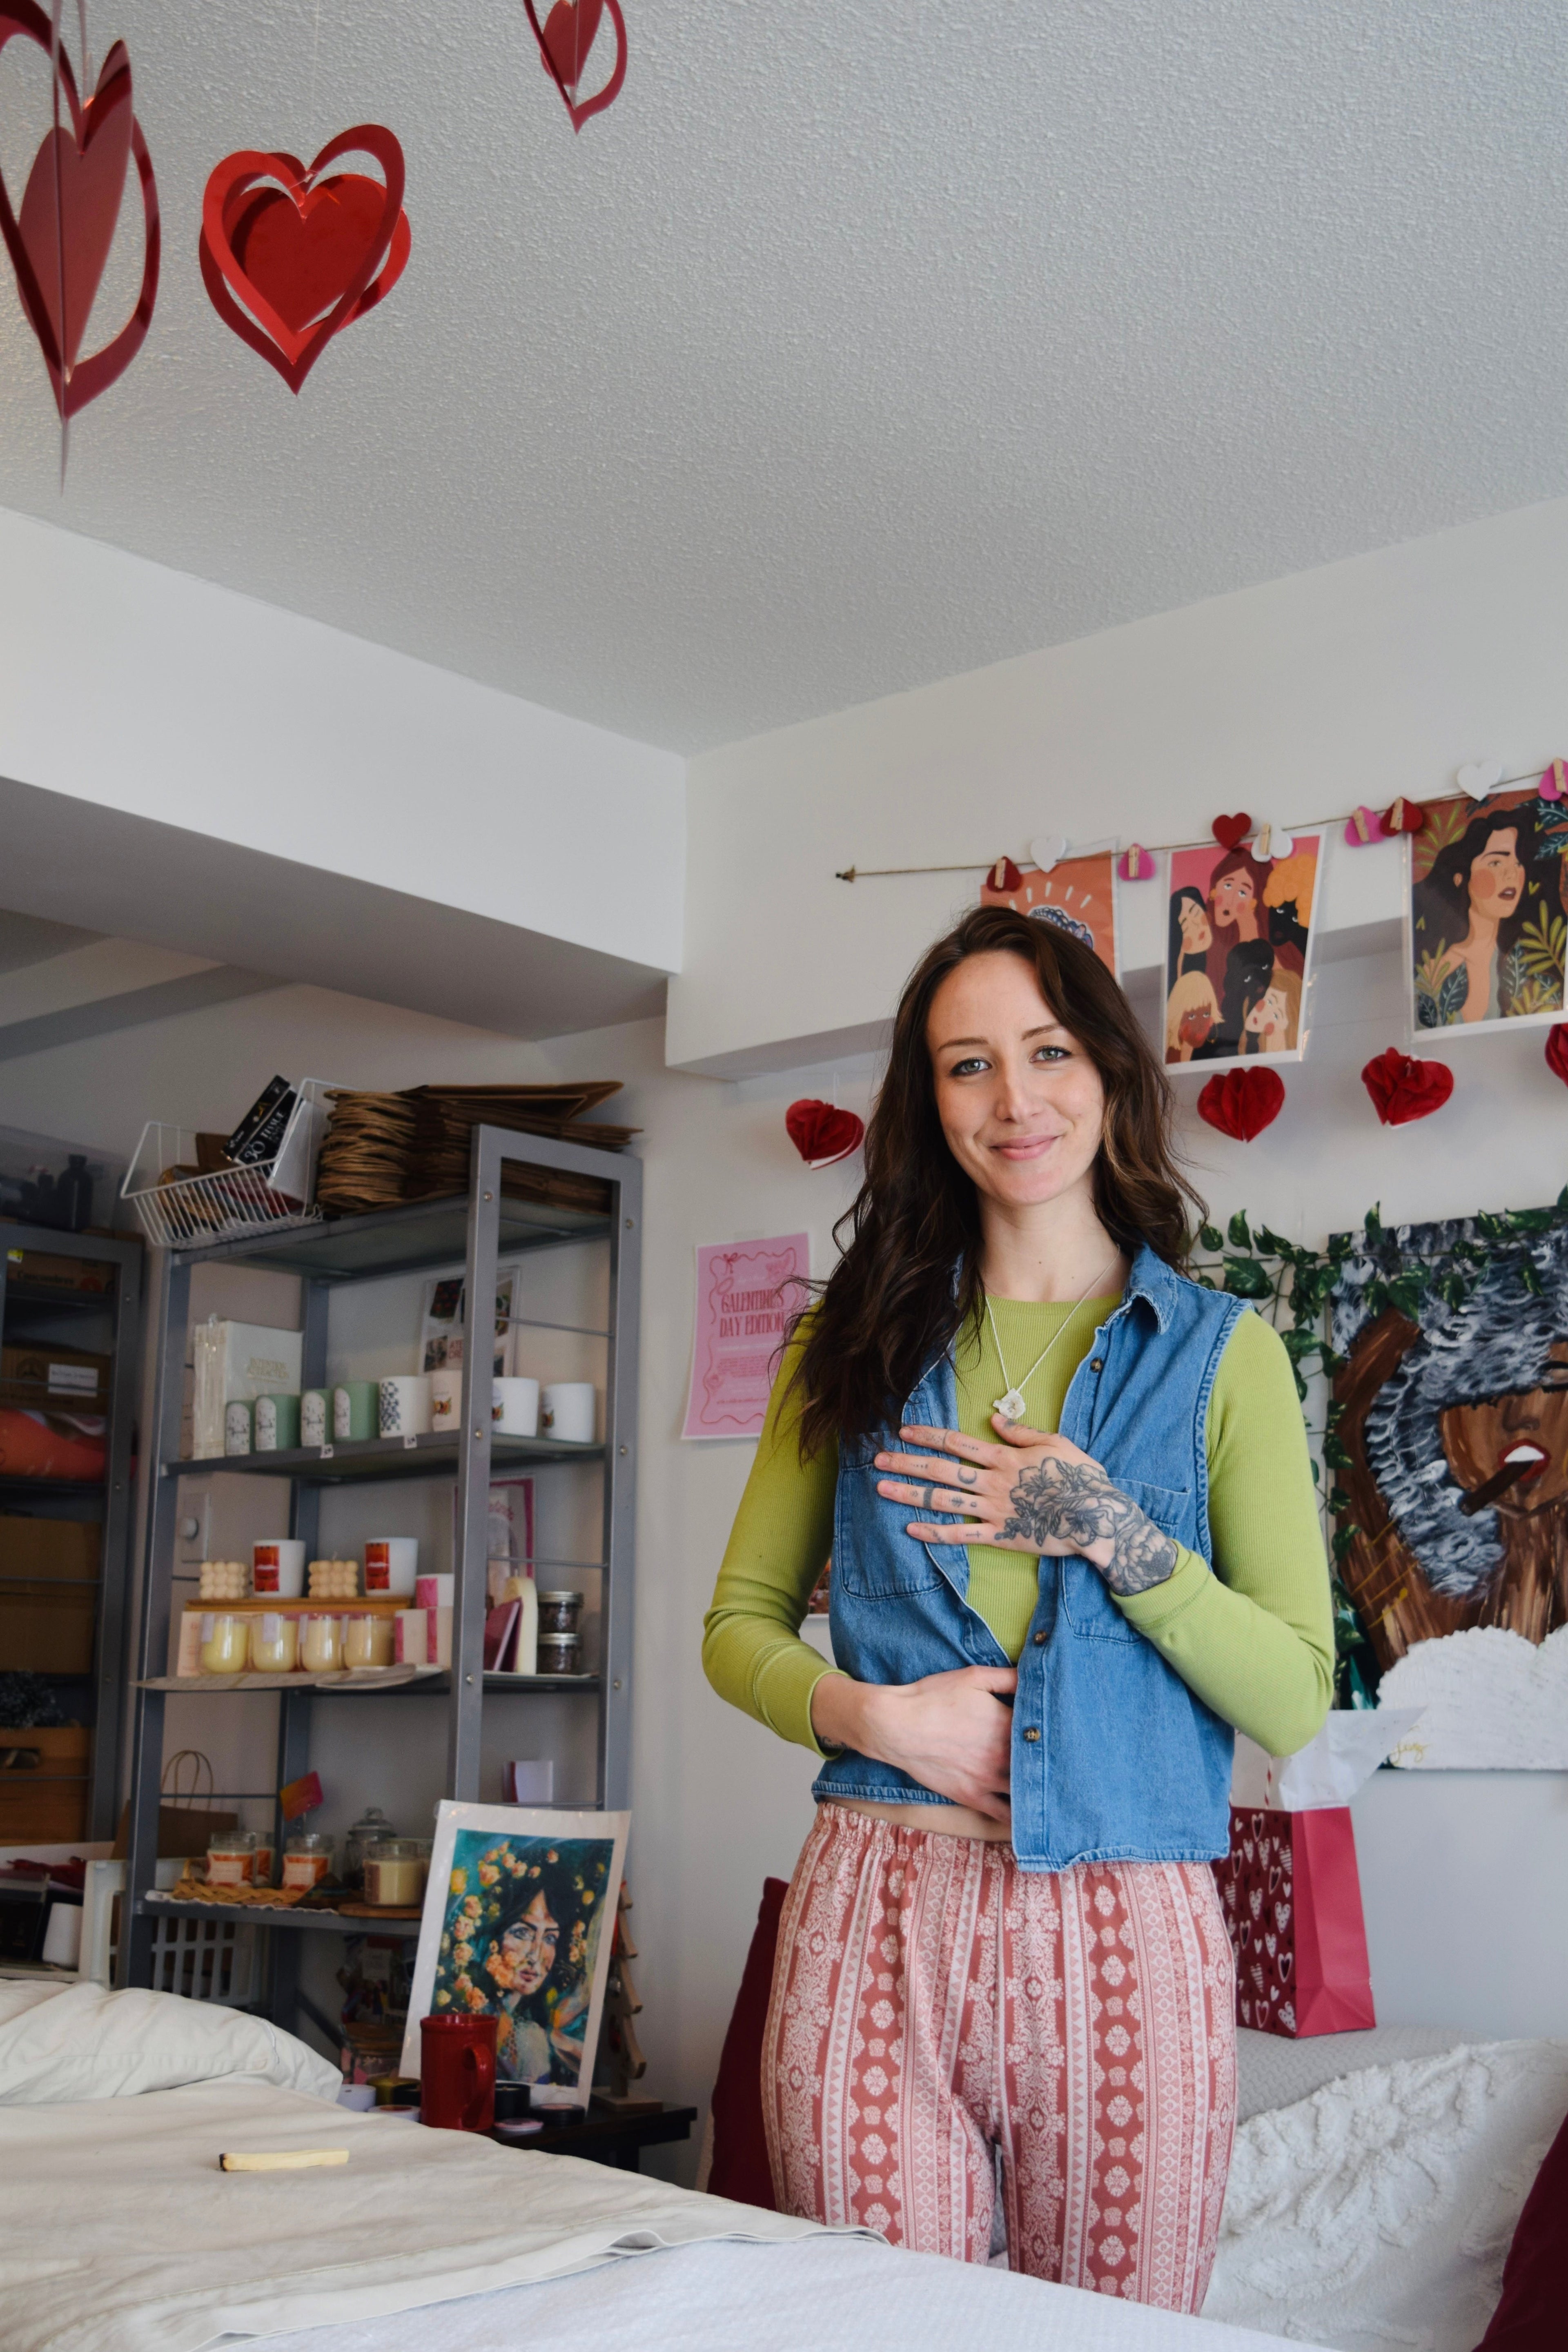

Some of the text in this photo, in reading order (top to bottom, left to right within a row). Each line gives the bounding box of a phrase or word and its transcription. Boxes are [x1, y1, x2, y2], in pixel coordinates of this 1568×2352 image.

[244, 1140, 265, 1160] 30
[260, 1111, 285, 1138] TISSUE
[719, 1312, 784, 1338] DAY EDITION
